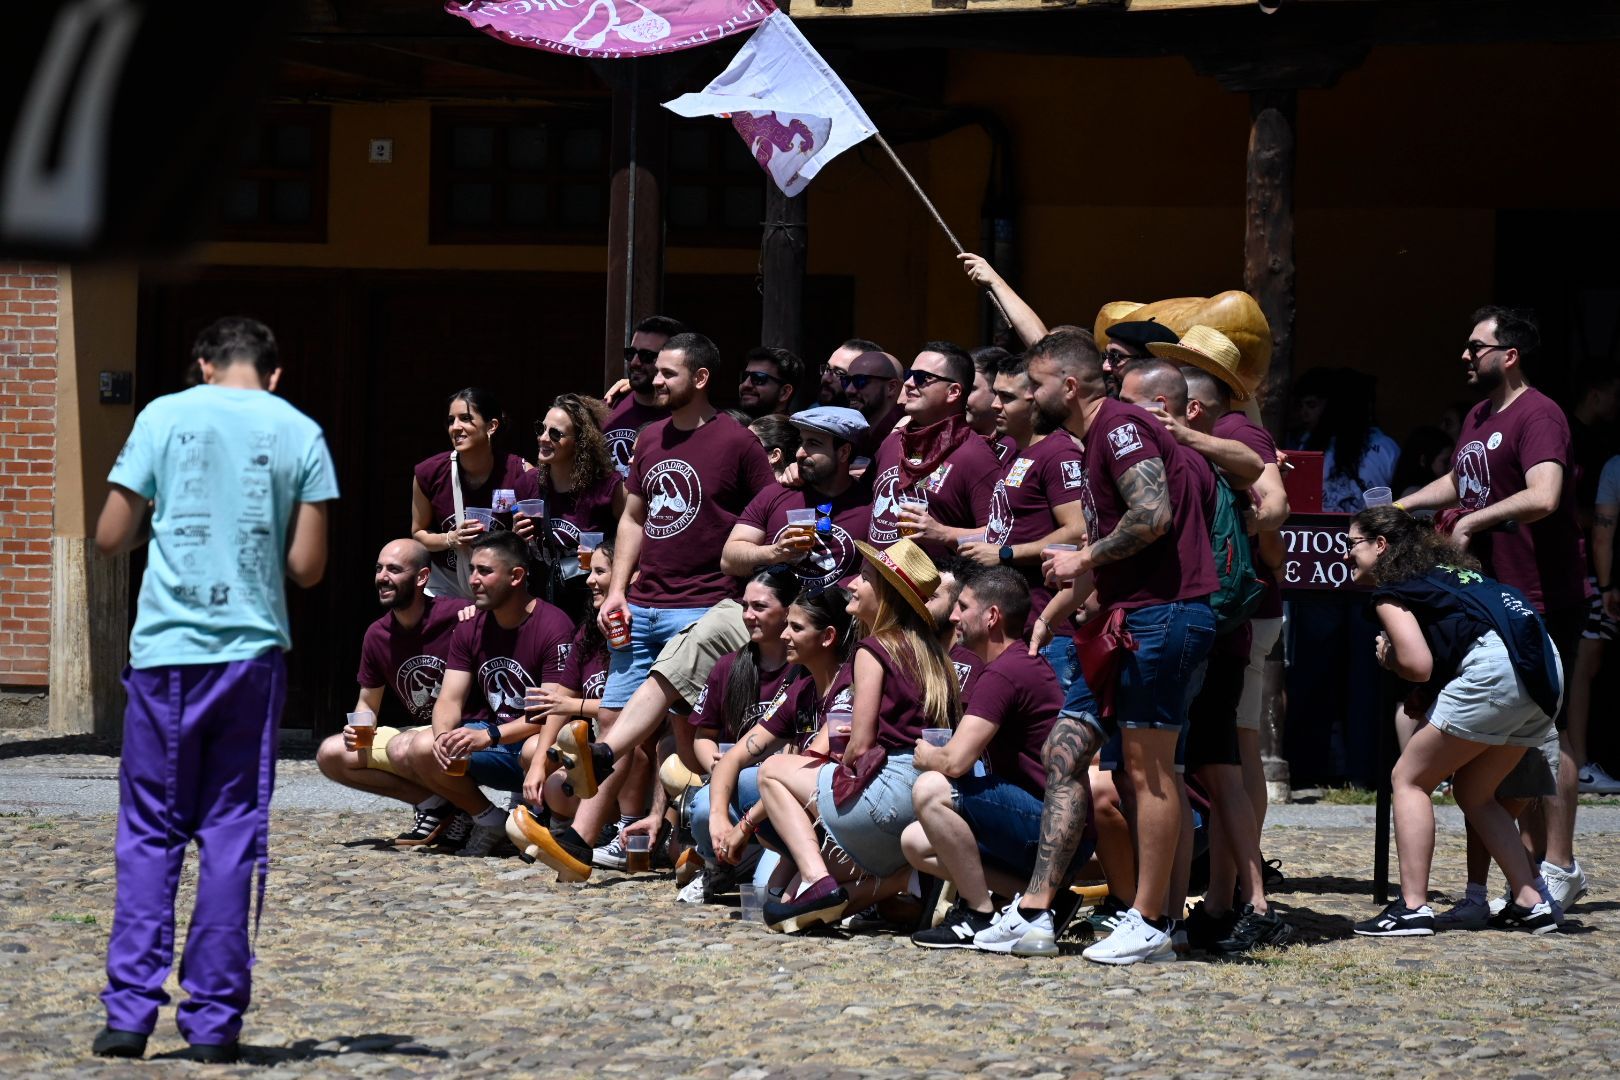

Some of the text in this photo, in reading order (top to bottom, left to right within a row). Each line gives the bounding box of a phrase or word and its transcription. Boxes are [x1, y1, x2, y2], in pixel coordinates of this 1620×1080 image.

[376, 144, 385, 157] 2
[648, 470, 658, 481] LA
[1279, 530, 1349, 554] NTOS
[1284, 560, 1302, 583] E
